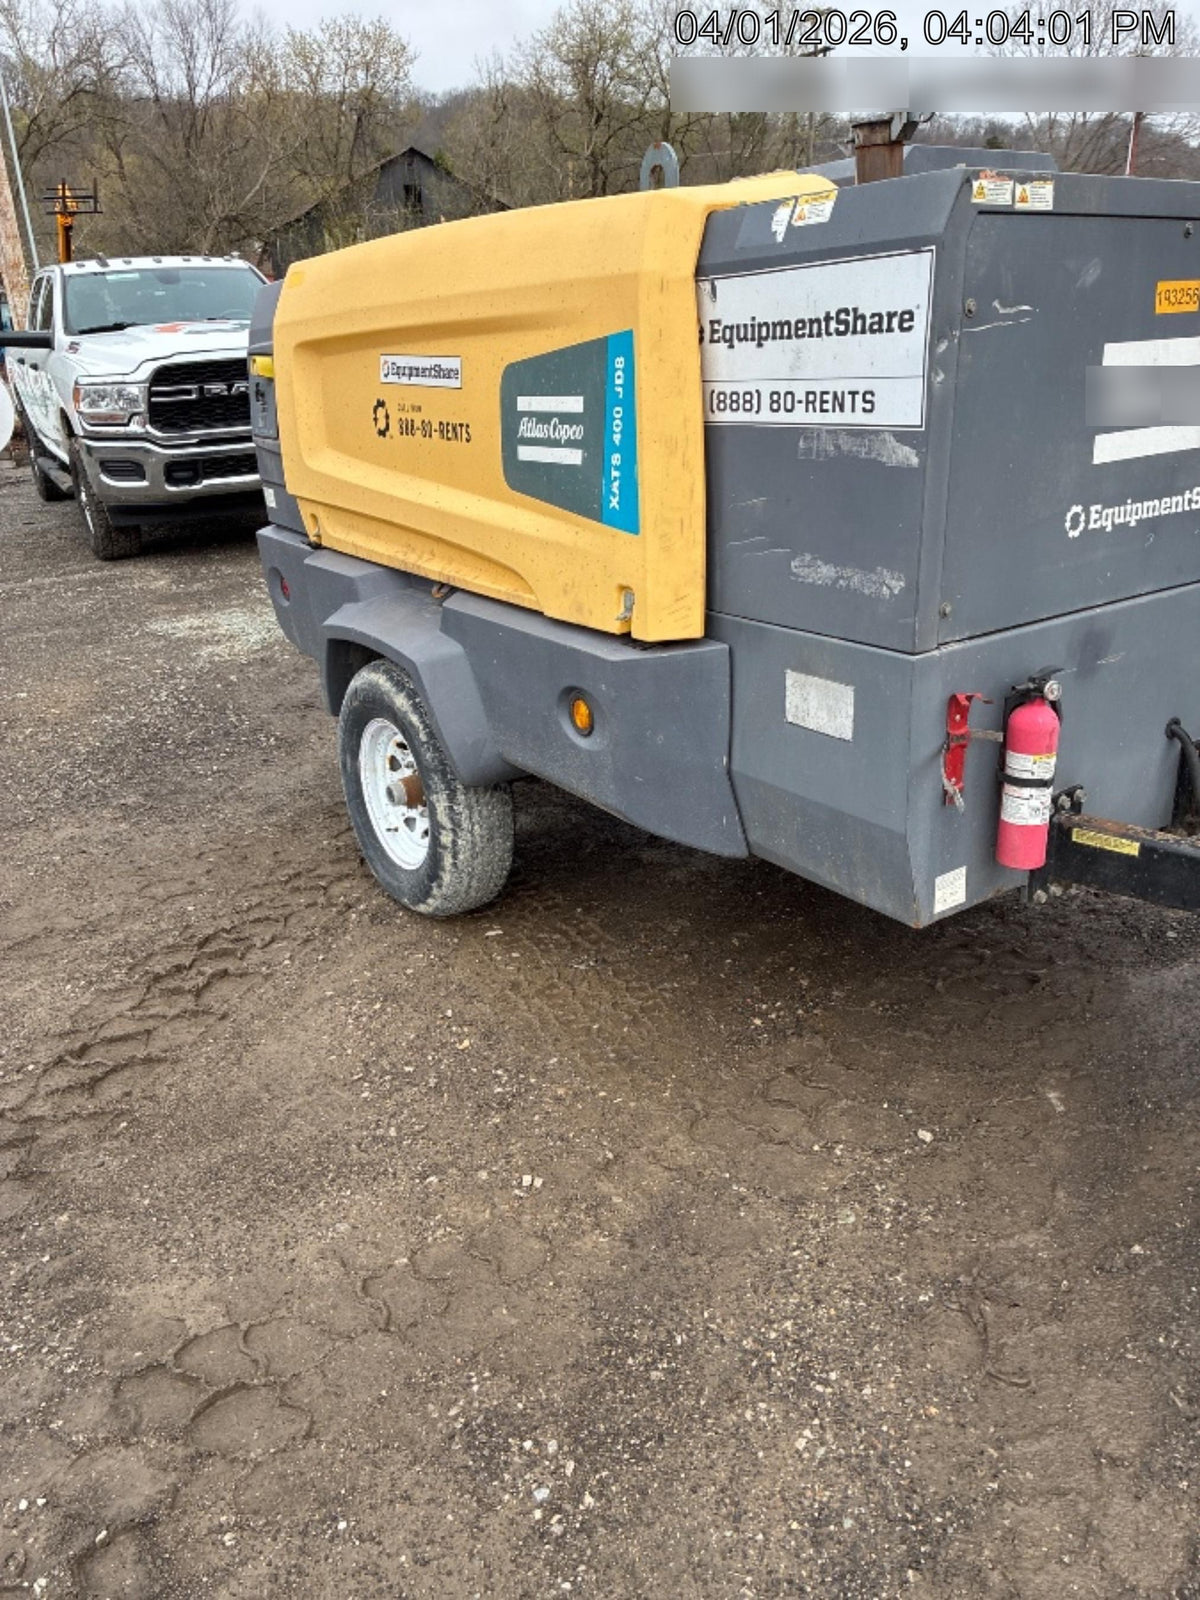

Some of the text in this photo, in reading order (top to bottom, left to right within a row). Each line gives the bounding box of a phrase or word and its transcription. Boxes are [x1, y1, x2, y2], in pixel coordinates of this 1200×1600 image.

[708, 306, 915, 349] EquipmentShare
[390, 362, 460, 381] EquipmentShare
[710, 389, 876, 414] (888) 80-RENTS
[398, 417, 472, 444] 888-80-RENTS
[517, 417, 584, 445] Atlas Copco
[613, 406, 623, 447] 400
[609, 452, 622, 511] XATS
